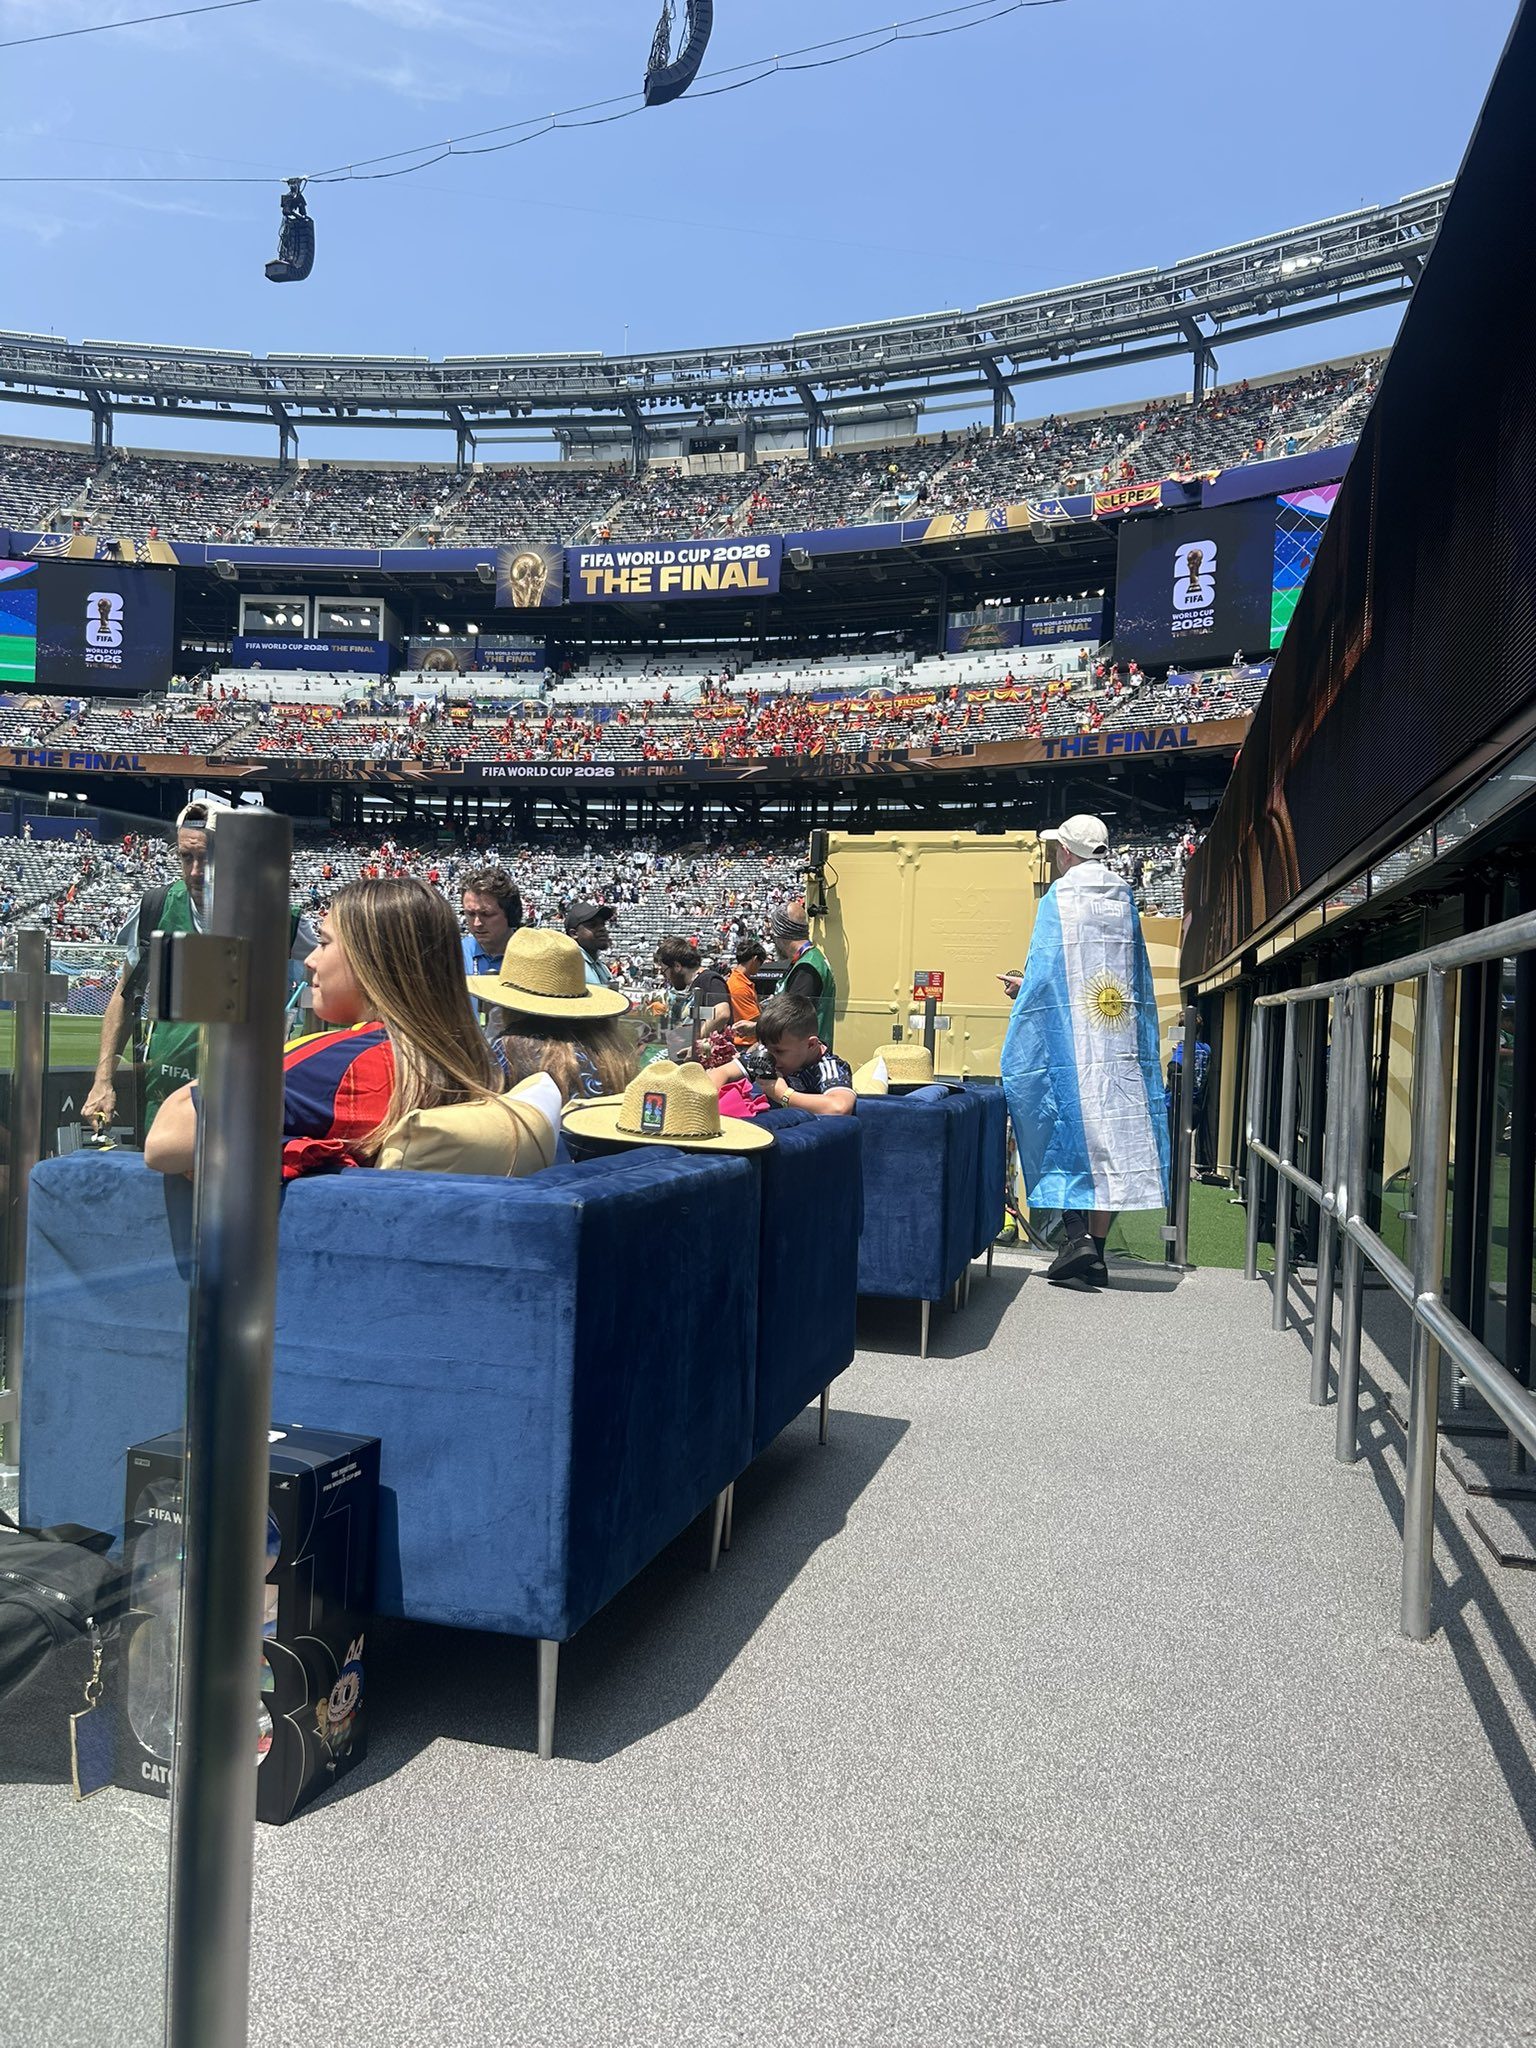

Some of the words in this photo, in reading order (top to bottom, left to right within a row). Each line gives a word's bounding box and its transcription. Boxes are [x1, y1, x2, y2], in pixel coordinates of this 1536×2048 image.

[1111, 490, 1144, 506] LEPE
[580, 553, 615, 568] FIFA
[617, 550, 675, 566] WORLD
[678, 548, 709, 563] CUP
[713, 544, 770, 562] 2026
[580, 567, 653, 594] THE
[660, 561, 769, 592] FINAL
[1184, 595, 1203, 604] FIFA
[1172, 611, 1198, 620] WORLD
[1199, 609, 1214, 617] CUP
[1032, 625, 1054, 636] THE
[1056, 622, 1091, 633] FINAL
[1171, 617, 1214, 631] 2026
[96, 635, 113, 643] FIFA
[349, 645, 375, 653] FINAL
[85, 654, 122, 664] 2026
[506, 655, 535, 663] FINAL
[1042, 736, 1099, 758] THE
[1106, 726, 1197, 754] FINAL
[10, 749, 63, 767] THE
[69, 752, 146, 771] FINAL
[482, 766, 505, 777] FIFA
[508, 766, 548, 777] WORLD
[550, 766, 573, 777] CUP
[574, 766, 615, 777] 2026
[619, 766, 646, 776] THE
[647, 765, 687, 776] FINAL
[161, 1064, 190, 1080] FIFA
[148, 1507, 172, 1522] FIFA
